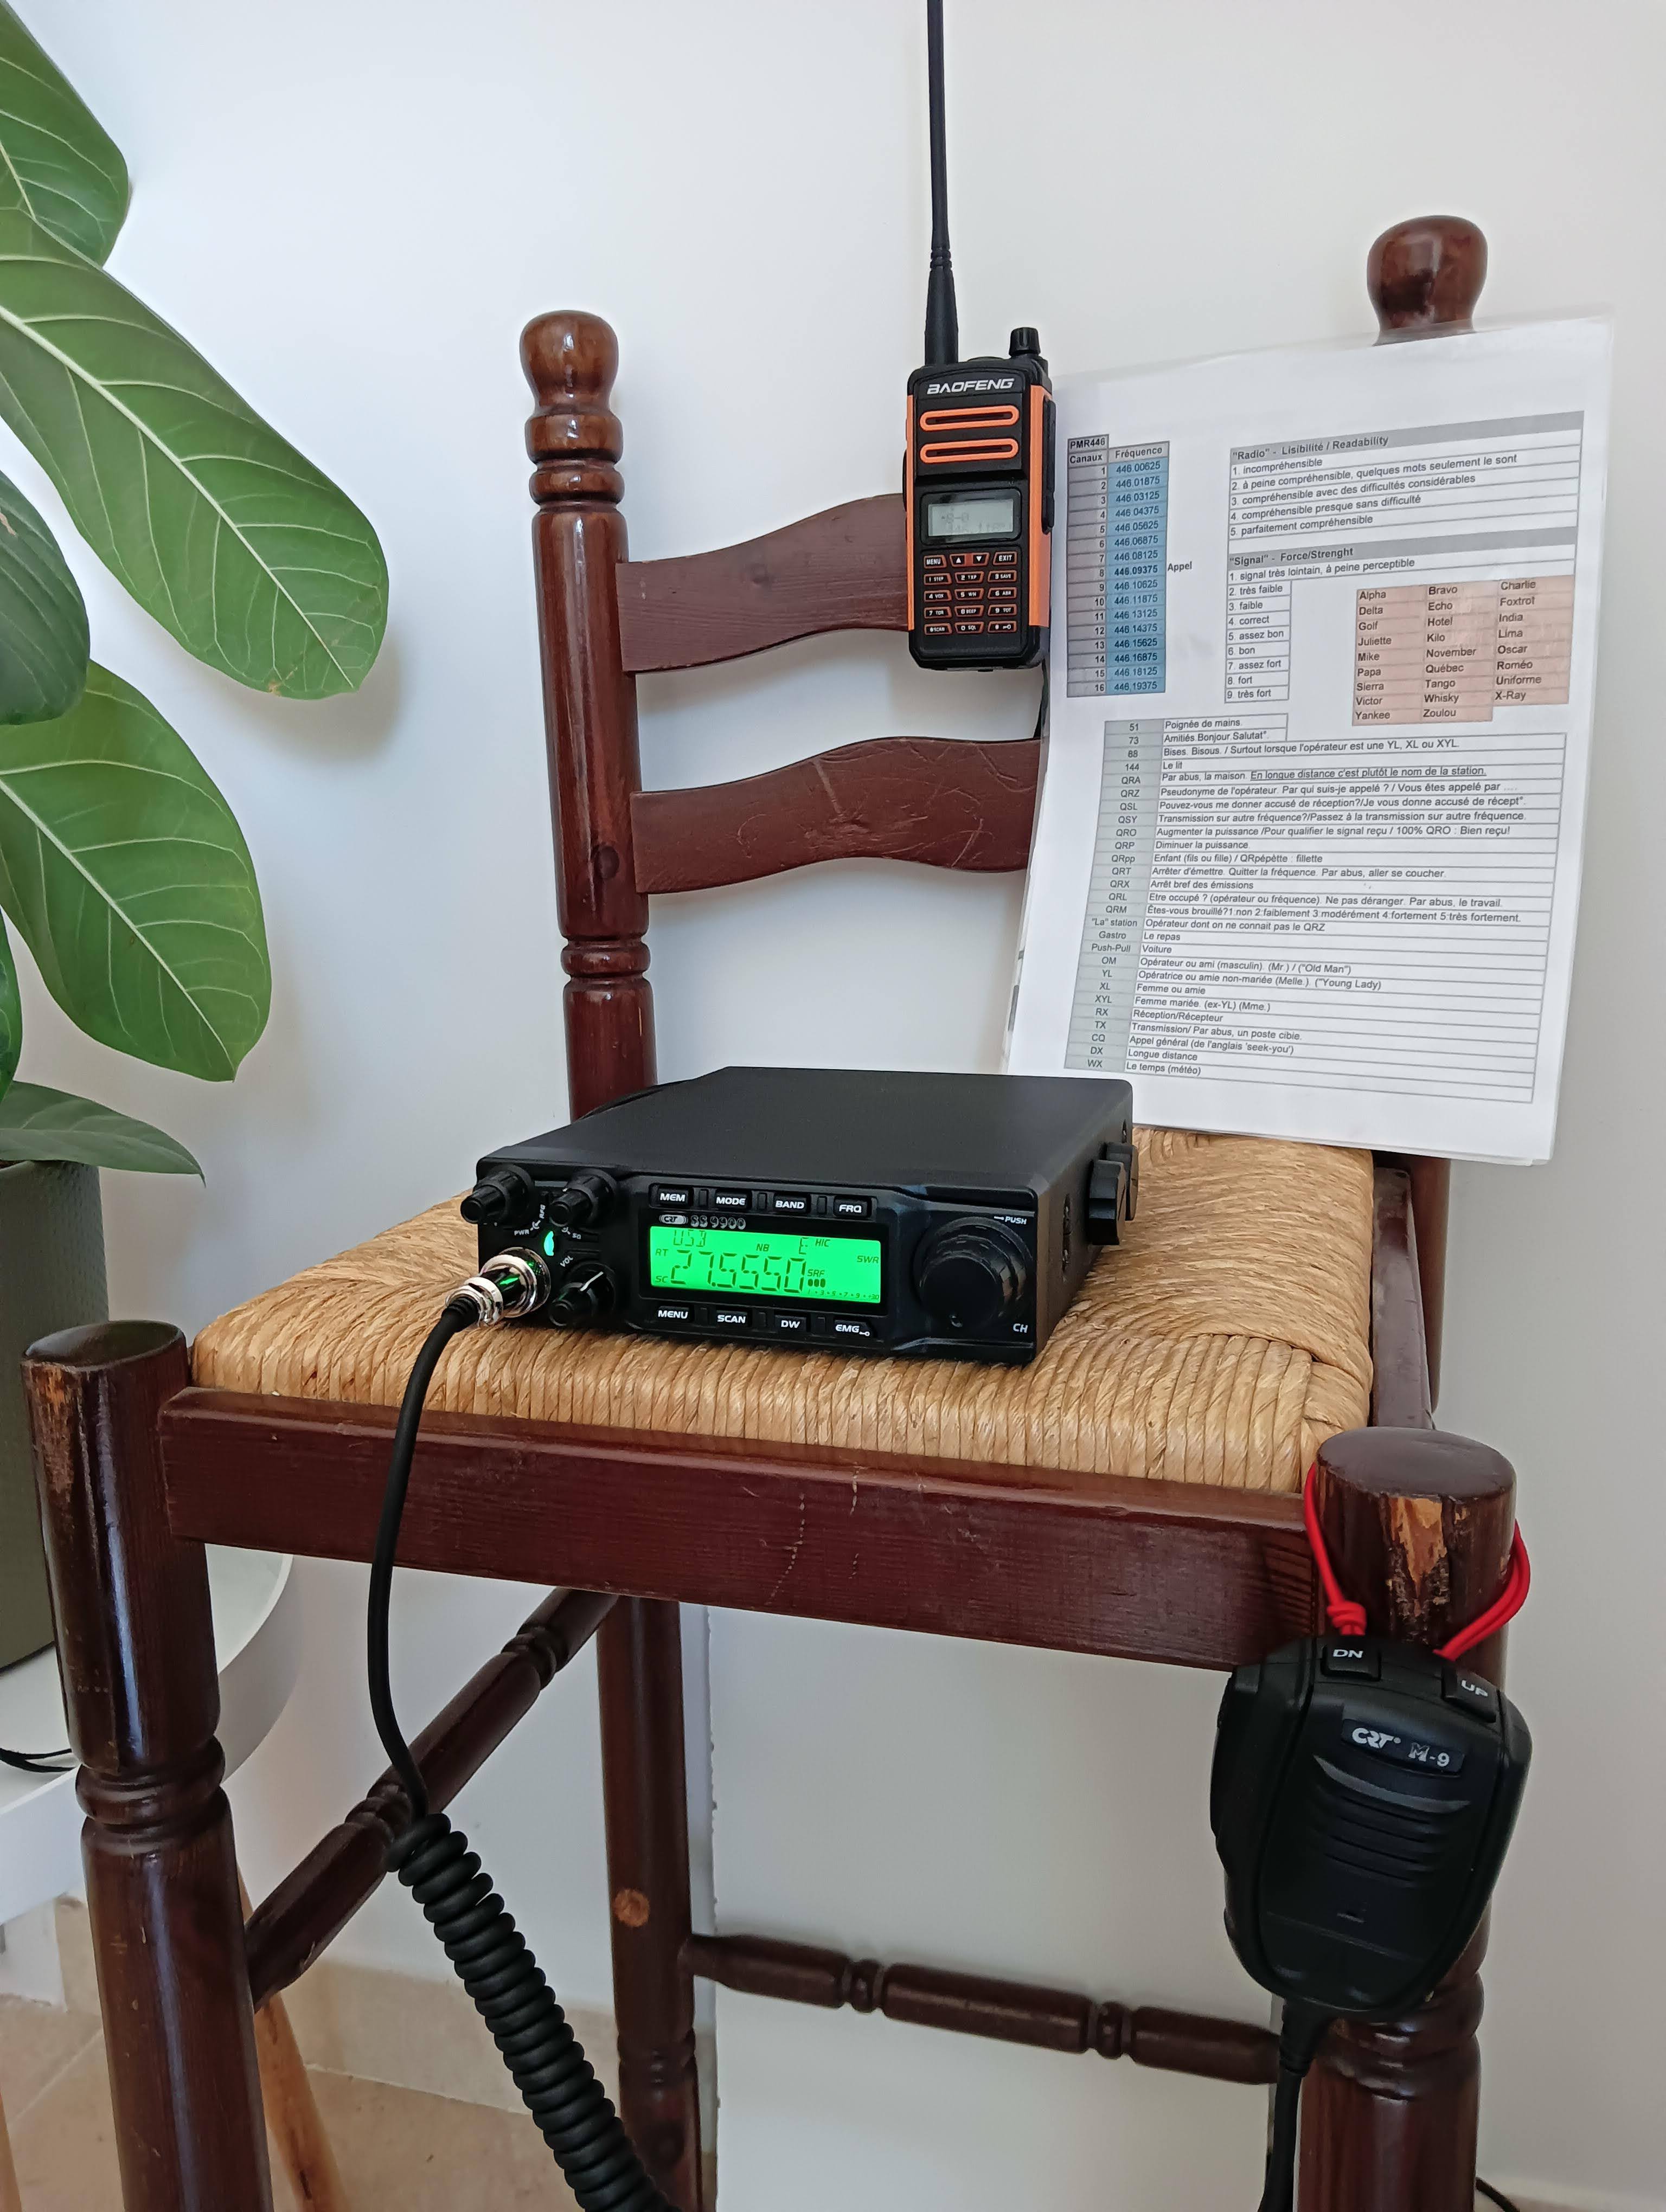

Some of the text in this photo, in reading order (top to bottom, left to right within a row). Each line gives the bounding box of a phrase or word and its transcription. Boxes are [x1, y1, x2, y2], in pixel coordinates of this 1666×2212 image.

[927, 378, 1014, 394] BAOFENG
[1070, 438, 1105, 449] PMR446
[1282, 443, 1323, 455] Lisibilité
[1332, 436, 1388, 450] Readability
[1115, 447, 1162, 459] Fréquence
[1070, 454, 1103, 464] Canaux
[1243, 459, 1323, 474] incompréhensible
[1243, 480, 1248, 489] à
[1251, 479, 1275, 490] peine
[1278, 471, 1354, 486] compréhensible,
[1356, 467, 1400, 479] quelques
[1402, 464, 1426, 473] mots
[1430, 458, 1481, 471] seulement
[1496, 454, 1517, 464] sont
[1242, 488, 1313, 504] compréhensible
[1341, 486, 1357, 494] des
[1360, 480, 1405, 493] difficultés
[1408, 475, 1476, 488] considérables
[1280, 548, 1354, 562] Force/Strenght
[1114, 565, 1158, 576] 446.09375
[1168, 562, 1192, 573] Appel
[1501, 580, 1536, 590] Charlie
[1240, 586, 1256, 595] très
[1259, 585, 1283, 593] faible
[1428, 586, 1458, 595] Bravo
[1359, 590, 1386, 601] Alpha
[1500, 596, 1535, 606] Foxtrot
[1359, 606, 1383, 614] Delta
[1428, 602, 1453, 610] Echo
[1239, 616, 1270, 625] correct
[1499, 613, 1523, 622] India
[1359, 621, 1378, 631] Golf
[1427, 618, 1453, 627] Hotel
[1427, 633, 1445, 642] Kilo
[1498, 629, 1523, 638] Lima
[1358, 636, 1392, 646] Juliette
[1426, 648, 1476, 658] November
[1497, 645, 1528, 654] Oscar
[1358, 652, 1380, 661] Mike
[1426, 664, 1464, 674] Québec
[1497, 661, 1533, 670] Roméo
[1357, 668, 1381, 677] Papa
[1425, 679, 1456, 689] Tango
[1496, 676, 1541, 685] Uniforme
[1356, 683, 1384, 691] Sierra
[1424, 693, 1459, 704] Whisky
[1495, 691, 1526, 701] X-Ray
[1356, 697, 1382, 705] Victor
[1356, 710, 1391, 720] Yankee
[1424, 709, 1457, 718] Zoulou
[1129, 723, 1139, 732] 51
[1165, 720, 1200, 731] Poignée
[1202, 720, 1213, 728] de
[1129, 736, 1139, 745] 73
[1128, 750, 1138, 758] 88
[1125, 763, 1139, 771] 144
[1163, 761, 1174, 770] Le
[1122, 776, 1140, 786] QRA
[1121, 789, 1139, 798] QRZ
[1120, 802, 1138, 812] QSL
[1118, 815, 1137, 825] QSY
[1116, 828, 1137, 838] QRO
[1115, 841, 1135, 850] QRP
[1156, 840, 1193, 849] Diminuer
[1195, 841, 1203, 849] la
[1111, 854, 1135, 864] QRpp
[1112, 867, 1131, 876] QRT
[1110, 879, 1130, 889] QRX
[1150, 879, 1253, 890] Arrêt bref des émissions
[1099, 931, 1126, 940] Gastro
[1144, 932, 1181, 943] Le repas
[1091, 943, 1131, 952] Push-Pull
[1143, 945, 1172, 954] Voiture
[1090, 1046, 1103, 1054] DX
[1128, 1049, 1197, 1060] Longue distance
[1126, 1062, 1201, 1075] Le temps (météo)
[660, 1193, 685, 1201] MEM
[716, 1197, 746, 1205] MODE
[776, 1201, 805, 1209] BAND
[839, 1205, 862, 1213] FRQ
[710, 1216, 746, 1230] 9900
[1005, 1216, 1027, 1225] PUSH
[756, 1244, 769, 1252] NB
[560, 1256, 573, 1267] VOL
[670, 1250, 806, 1293] 27.5550
[658, 1310, 688, 1319] MENU
[717, 1314, 746, 1323] SCAN
[781, 1320, 800, 1328] DW
[835, 1324, 860, 1333] EMG
[1013, 1323, 1028, 1333] CH
[1332, 1649, 1363, 1658] DN
[1462, 1681, 1489, 1697] UP
[1352, 1728, 1450, 1766] CRT M-9
